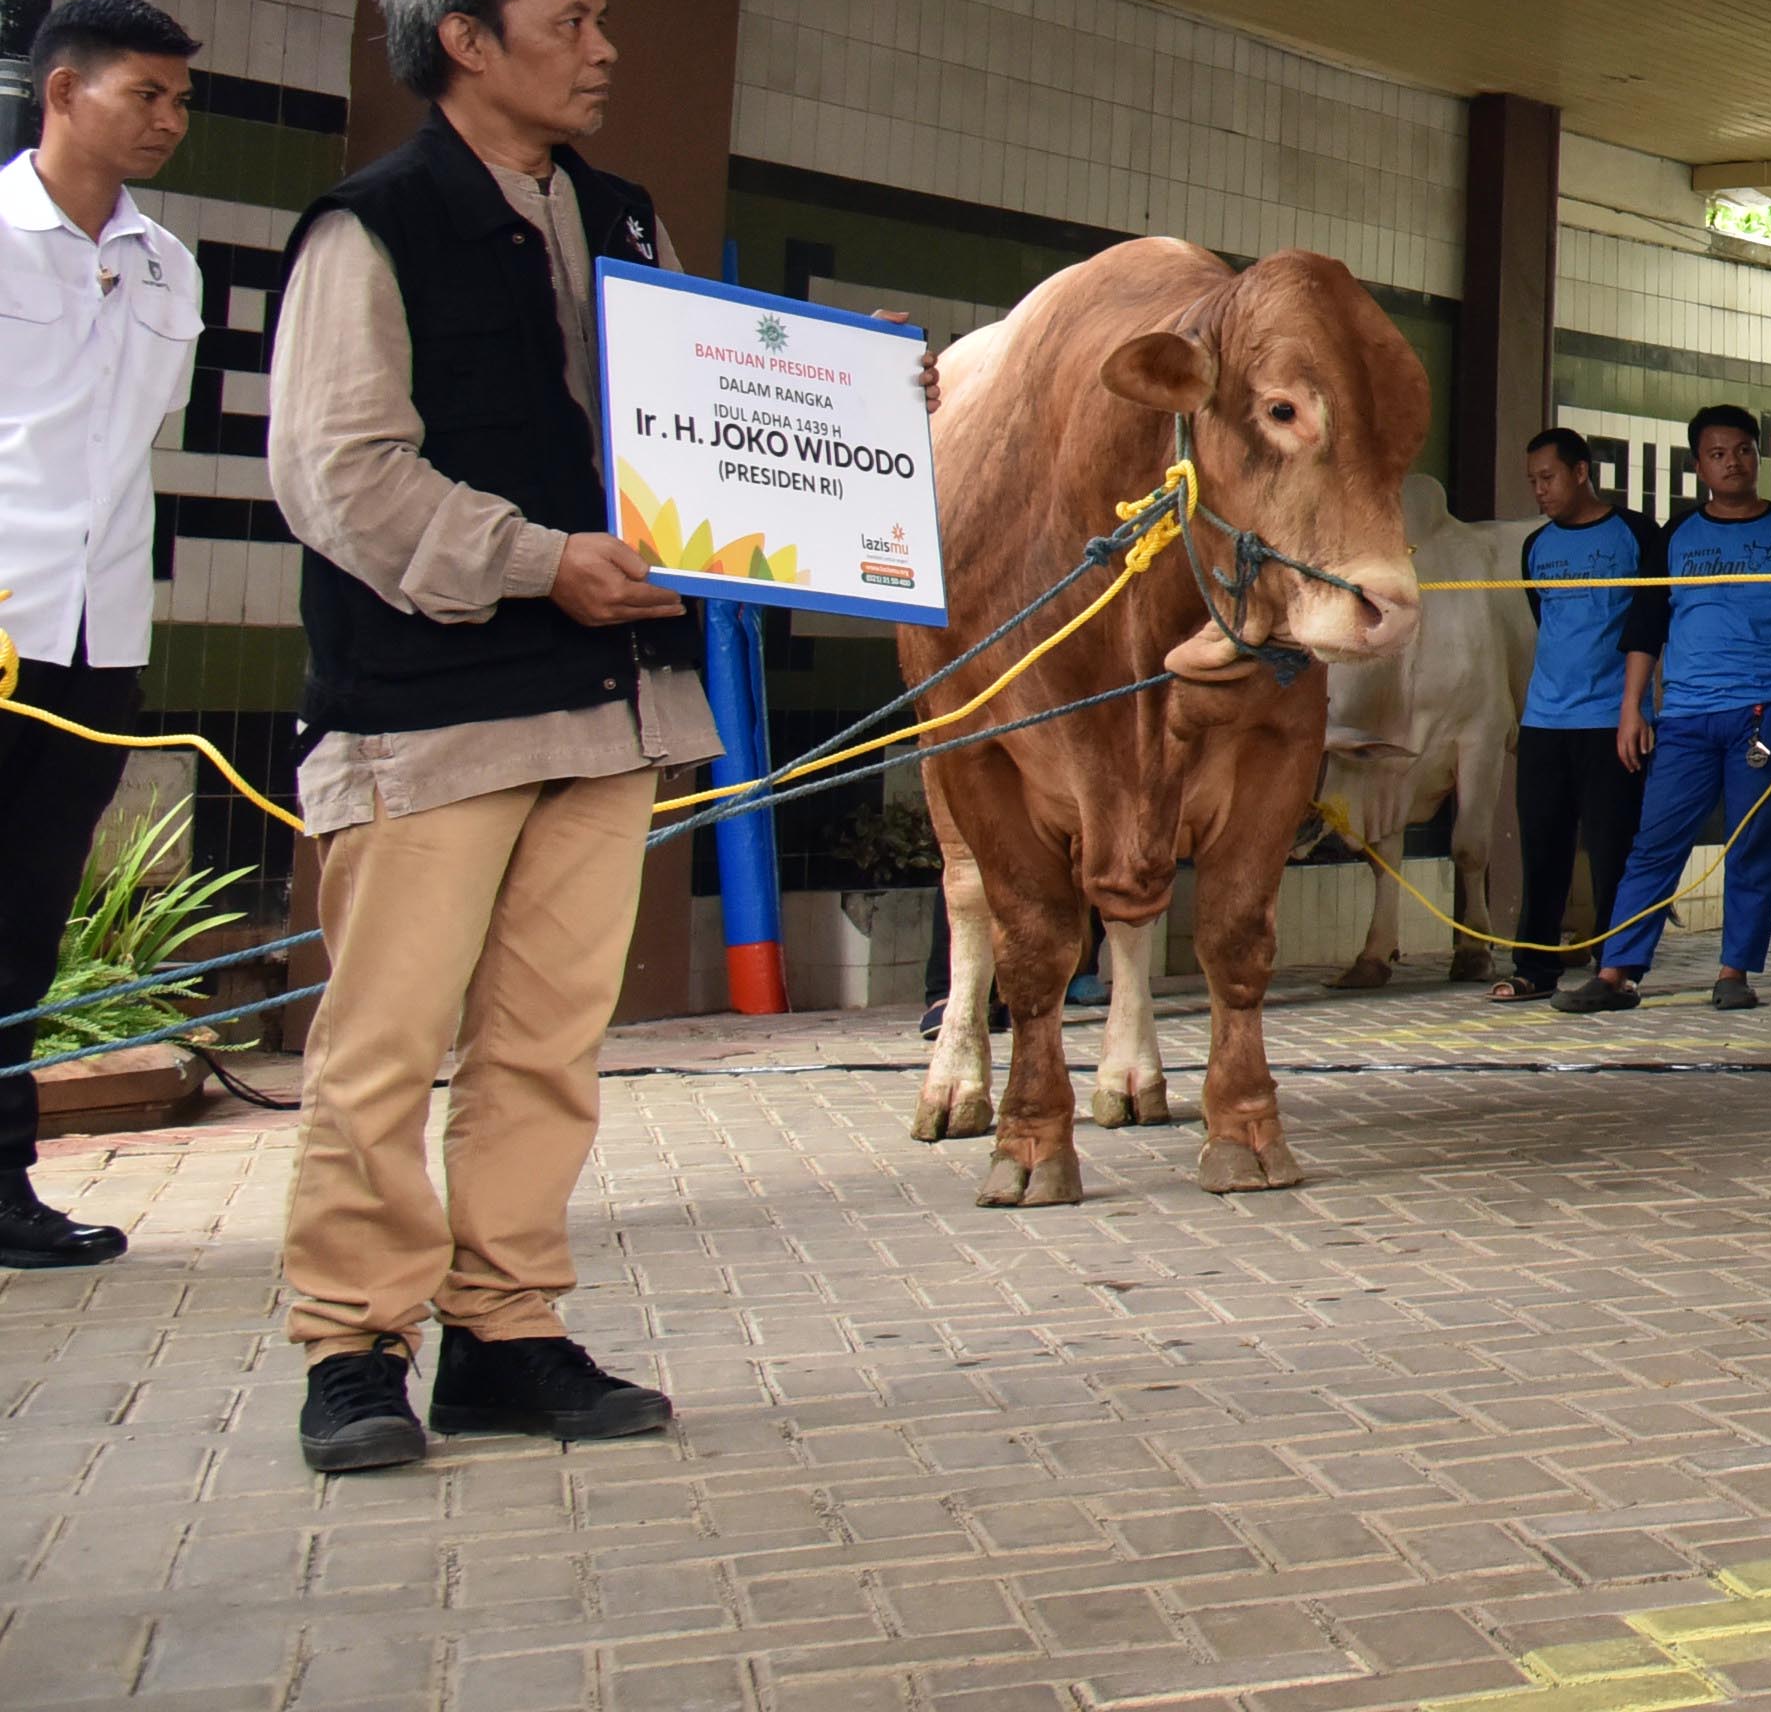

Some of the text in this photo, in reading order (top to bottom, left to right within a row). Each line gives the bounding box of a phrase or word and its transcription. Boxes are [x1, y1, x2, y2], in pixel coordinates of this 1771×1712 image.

[695, 343, 852, 386] BANTUAN PRESIDEN RI
[719, 375, 834, 410] DALAM RANGKA
[713, 403, 842, 439] IDUL ADHA 1439 H
[674, 413, 704, 444] H.
[710, 420, 789, 458] JOKO
[794, 434, 915, 479] WIDODO
[718, 460, 843, 500] (PRESIDEN RI)
[861, 533, 909, 555] lazismu
